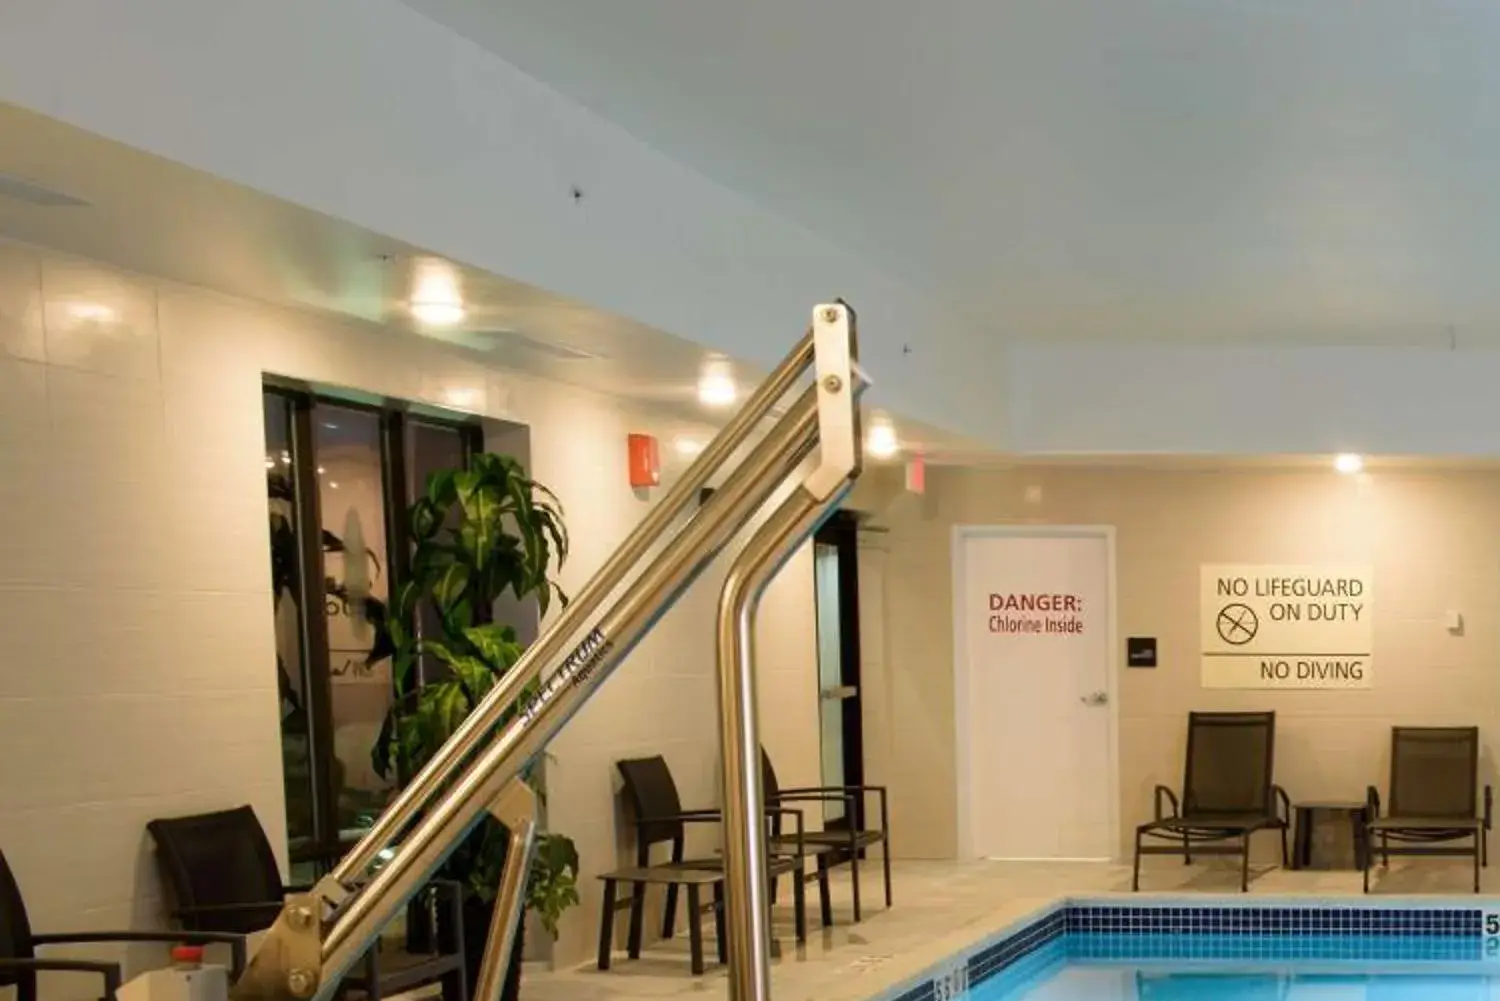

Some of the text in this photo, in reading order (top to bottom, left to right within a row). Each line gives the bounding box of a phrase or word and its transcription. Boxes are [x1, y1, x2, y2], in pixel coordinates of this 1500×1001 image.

[1217, 578, 1363, 597] NO LIFEGUARD
[989, 594, 1083, 612] DANGER:
[1269, 603, 1363, 621] ON DUTY
[989, 616, 1083, 633] Chlorine Inside
[1260, 661, 1363, 680] NO DIVING
[1485, 914, 1500, 935] 5
